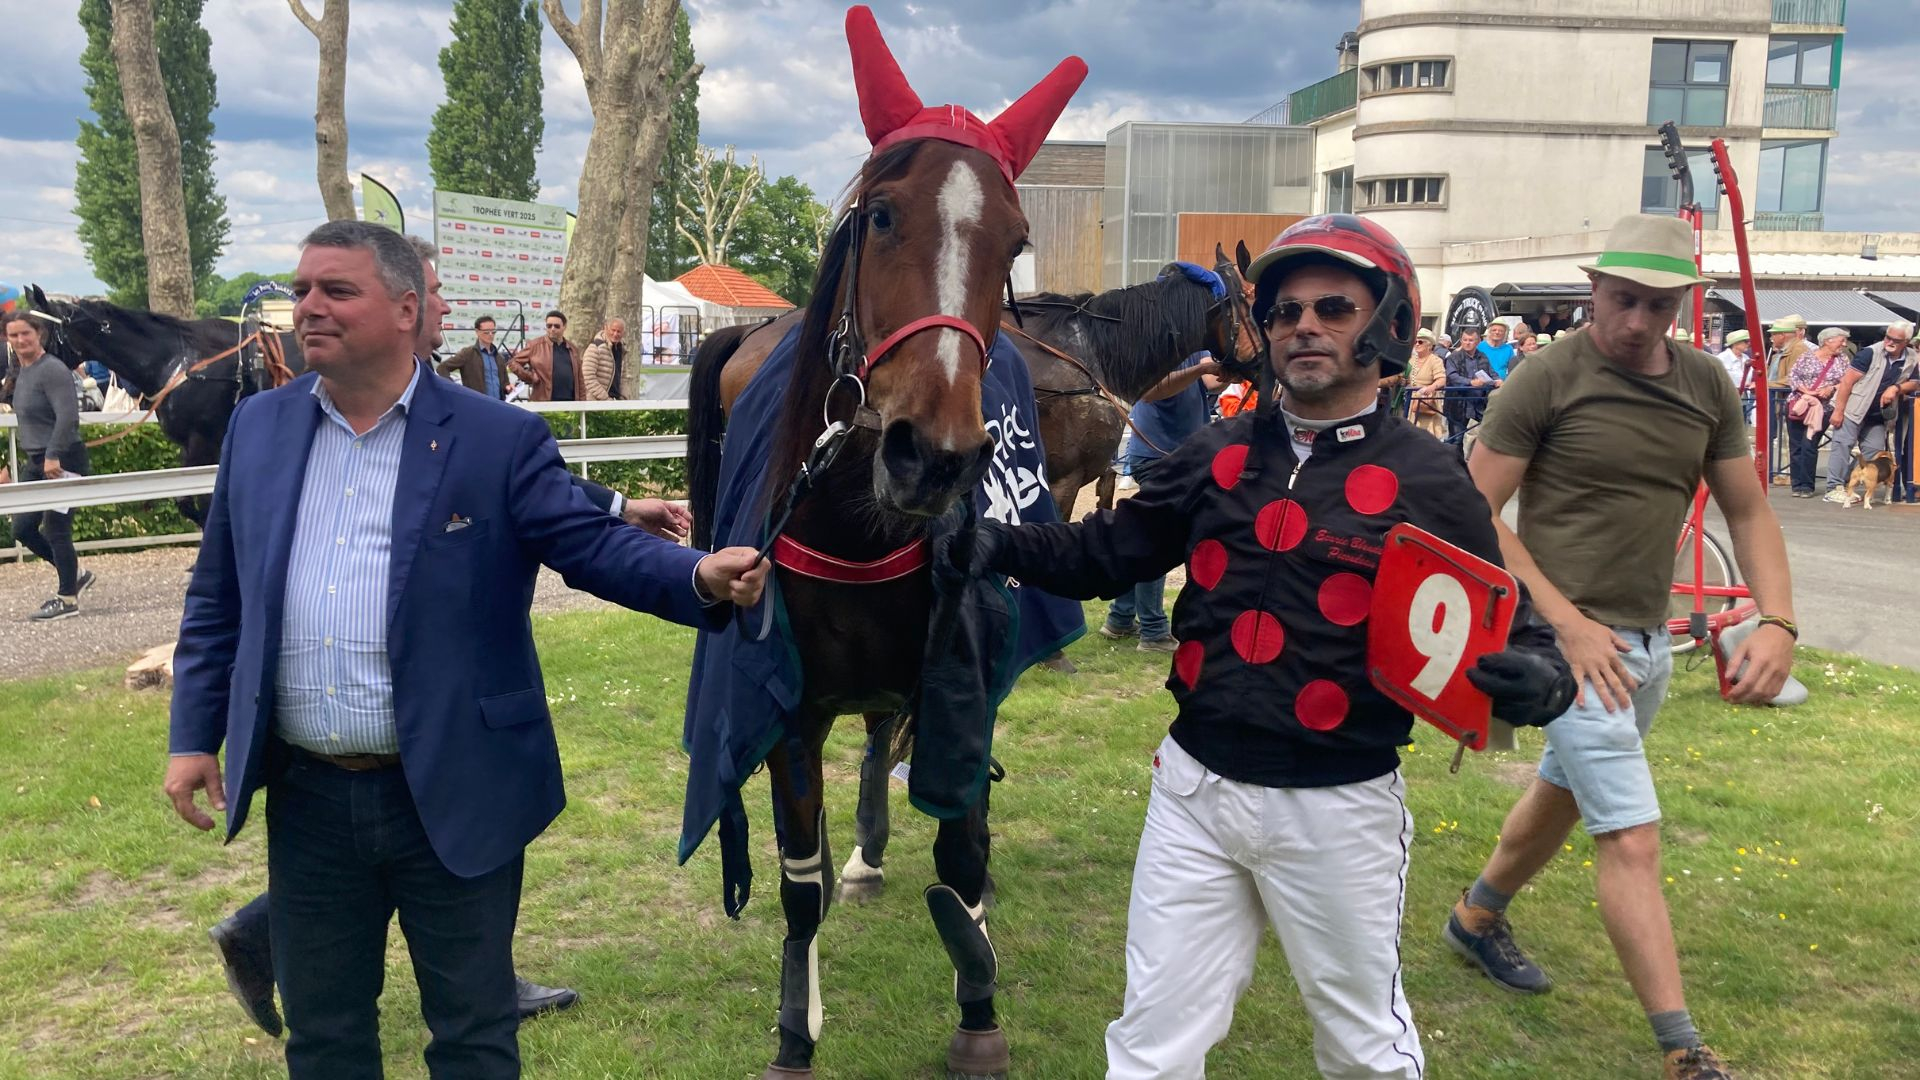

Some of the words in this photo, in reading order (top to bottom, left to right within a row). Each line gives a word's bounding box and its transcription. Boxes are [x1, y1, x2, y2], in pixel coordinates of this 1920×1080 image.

[503, 209, 519, 219] VERT
[520, 211, 536, 221] 2025
[1462, 297, 1480, 310] TRUCK
[1408, 573, 1471, 701] 9
